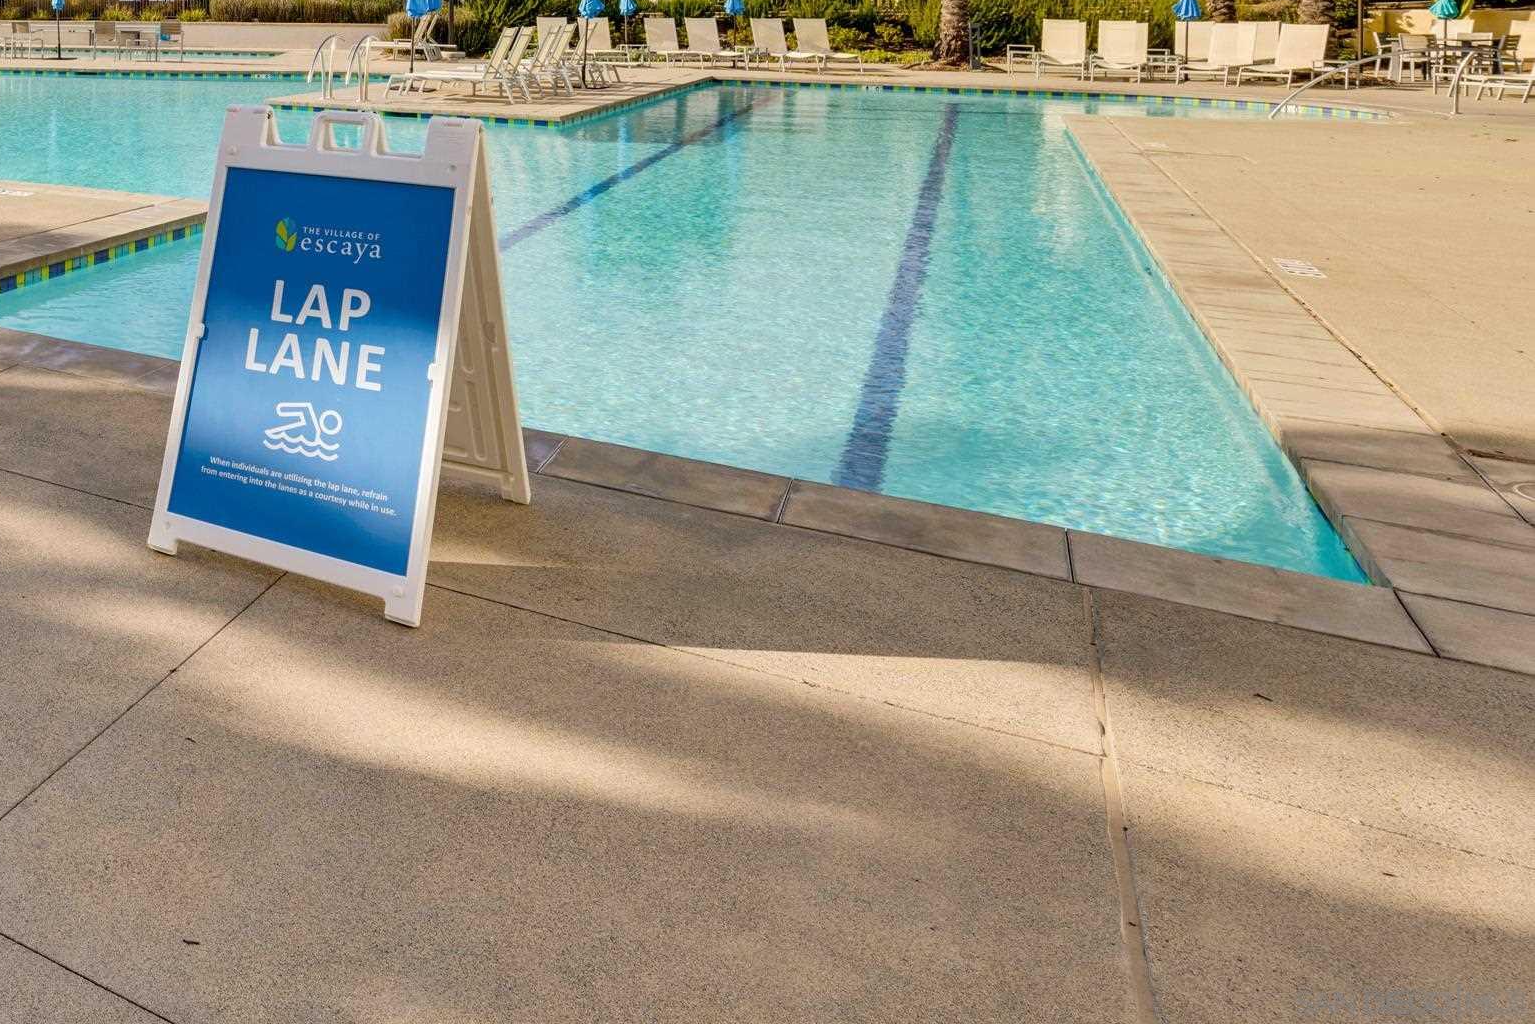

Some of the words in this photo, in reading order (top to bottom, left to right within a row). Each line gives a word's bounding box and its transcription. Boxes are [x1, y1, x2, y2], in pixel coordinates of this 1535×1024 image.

[300, 236, 382, 264] escaya
[302, 225, 321, 236] THE
[324, 228, 363, 240] VILLAGE
[367, 233, 382, 241] OF
[271, 279, 371, 331] LAP
[245, 327, 386, 392] LANE
[200, 465, 218, 476] from
[218, 472, 247, 483] entering
[248, 477, 263, 487] into
[264, 479, 277, 489] the
[278, 483, 298, 495] lanes
[298, 487, 307, 496] as
[314, 491, 347, 507] courtesy
[348, 499, 370, 511] while
[371, 502, 380, 513] in
[380, 507, 398, 517] use.
[210, 456, 230, 468] When
[231, 462, 270, 476] individuals
[270, 469, 283, 478] are
[283, 472, 313, 488] utilizing
[314, 479, 327, 489] the
[327, 481, 340, 492] lap
[341, 484, 360, 496] lane,
[361, 489, 388, 502] refrain
